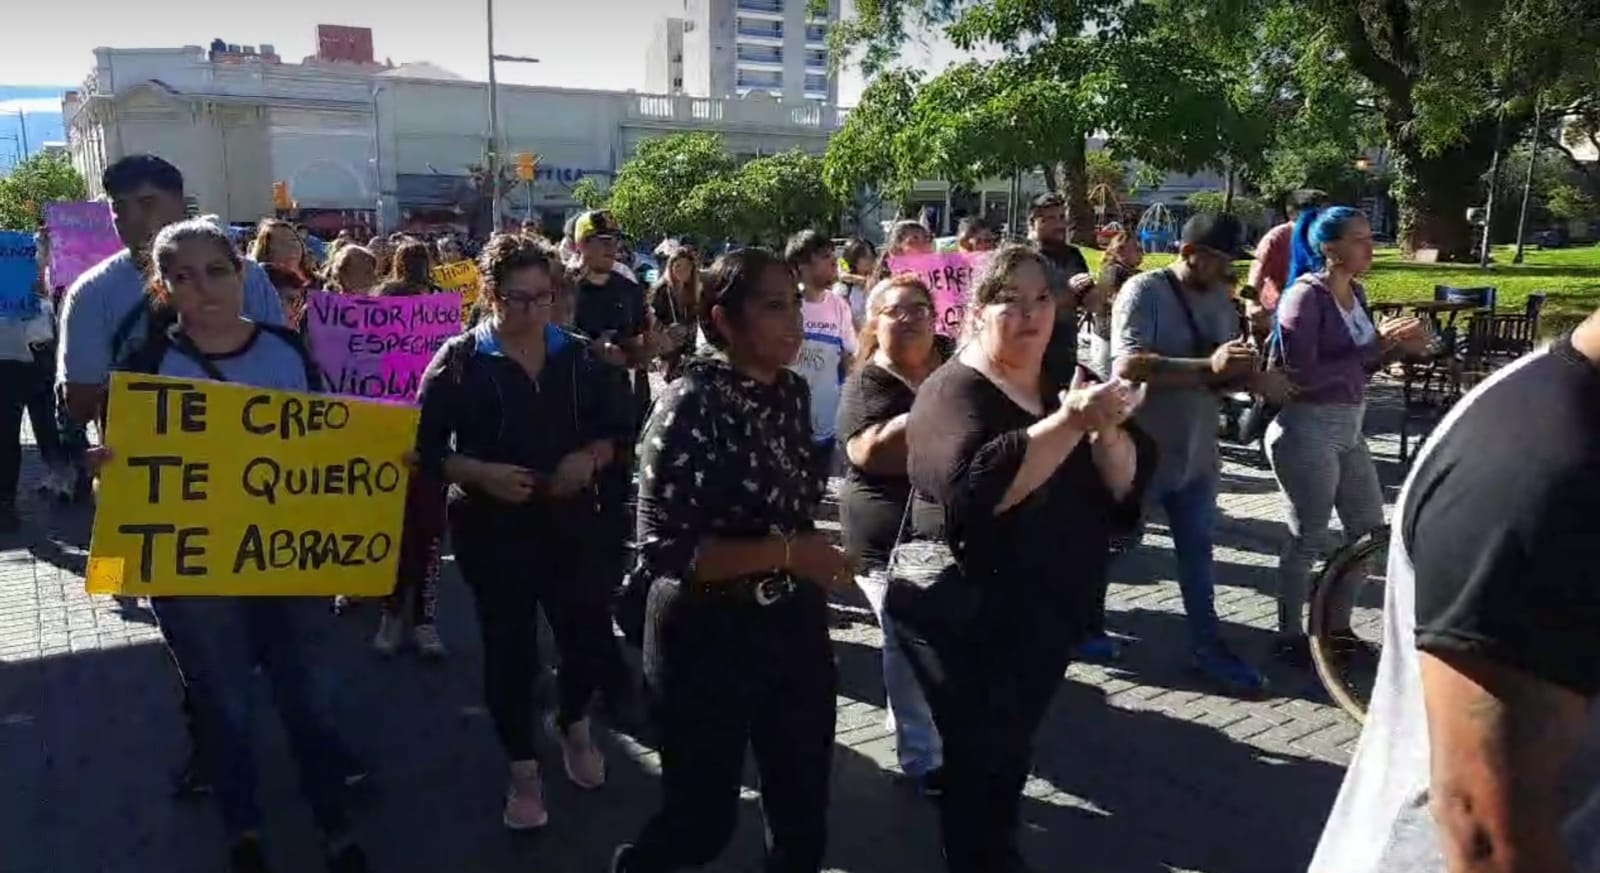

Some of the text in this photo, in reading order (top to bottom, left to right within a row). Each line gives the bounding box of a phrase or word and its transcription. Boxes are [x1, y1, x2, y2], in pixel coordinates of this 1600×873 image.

[312, 299, 406, 330] VICTOR
[410, 303, 461, 333] HUGO
[128, 382, 350, 440] TE CREO
[127, 456, 400, 505] TE QUIERO
[118, 524, 392, 584] TE ABRAZO
